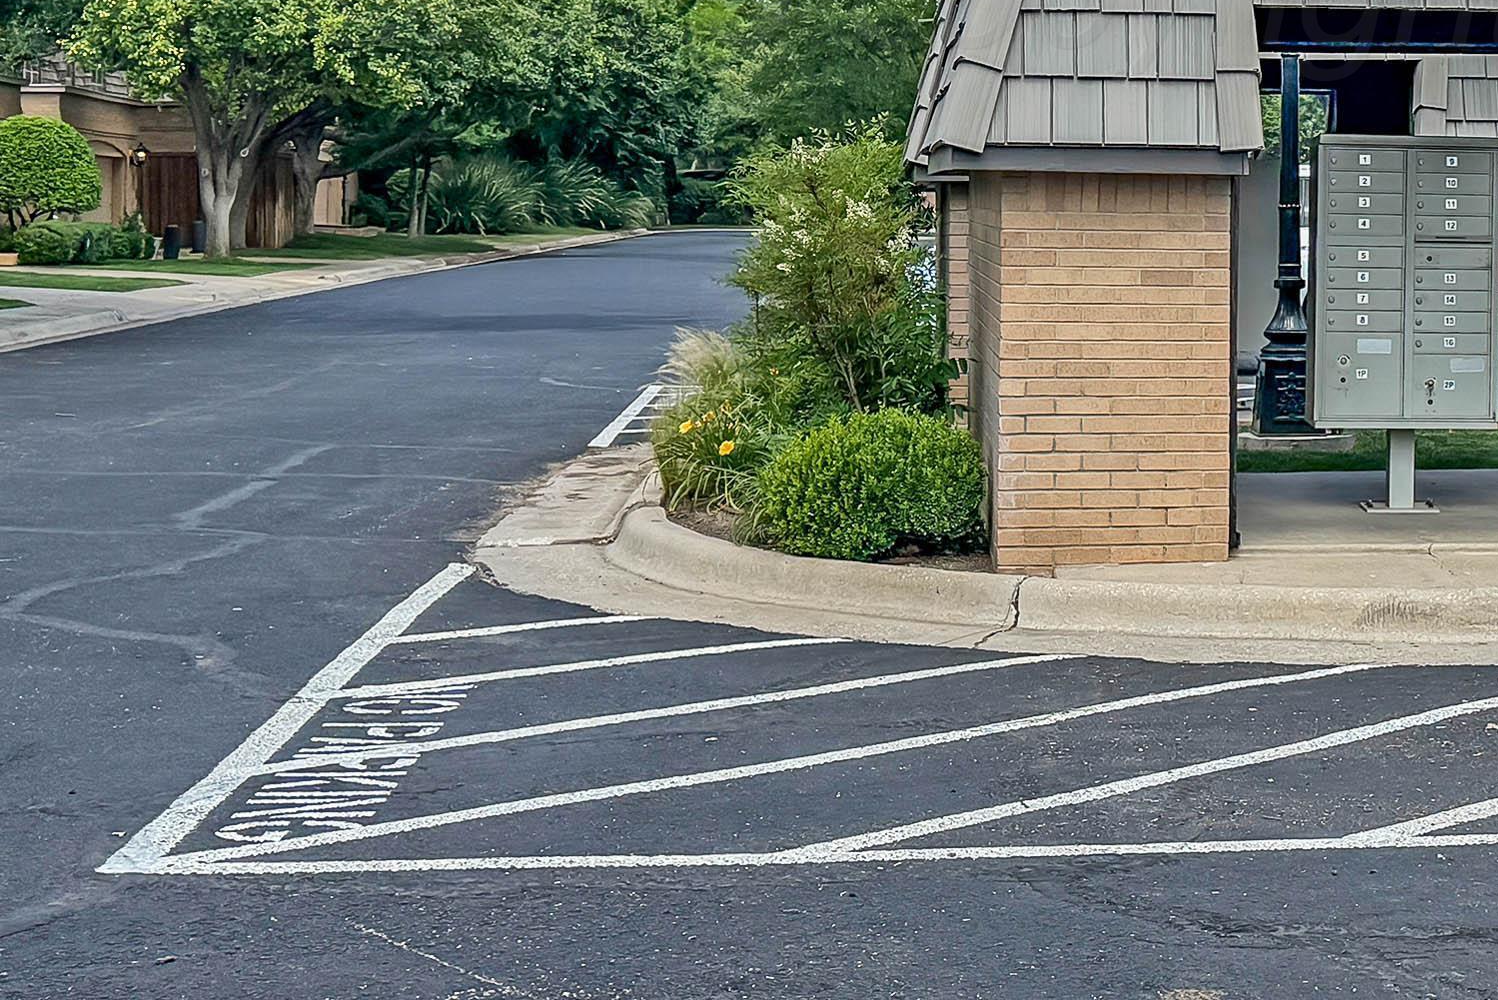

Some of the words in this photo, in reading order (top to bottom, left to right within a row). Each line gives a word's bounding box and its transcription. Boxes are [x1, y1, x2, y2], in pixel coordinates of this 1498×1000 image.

[1447, 179, 1457, 188] 10
[1447, 200, 1456, 208] 11
[1446, 221, 1456, 230] 12
[1446, 274, 1455, 283] 13
[1445, 295, 1455, 304] 14
[1357, 370, 1367, 378] 1P
[1444, 380, 1454, 389] 2P
[215, 721, 445, 842] PARKING
